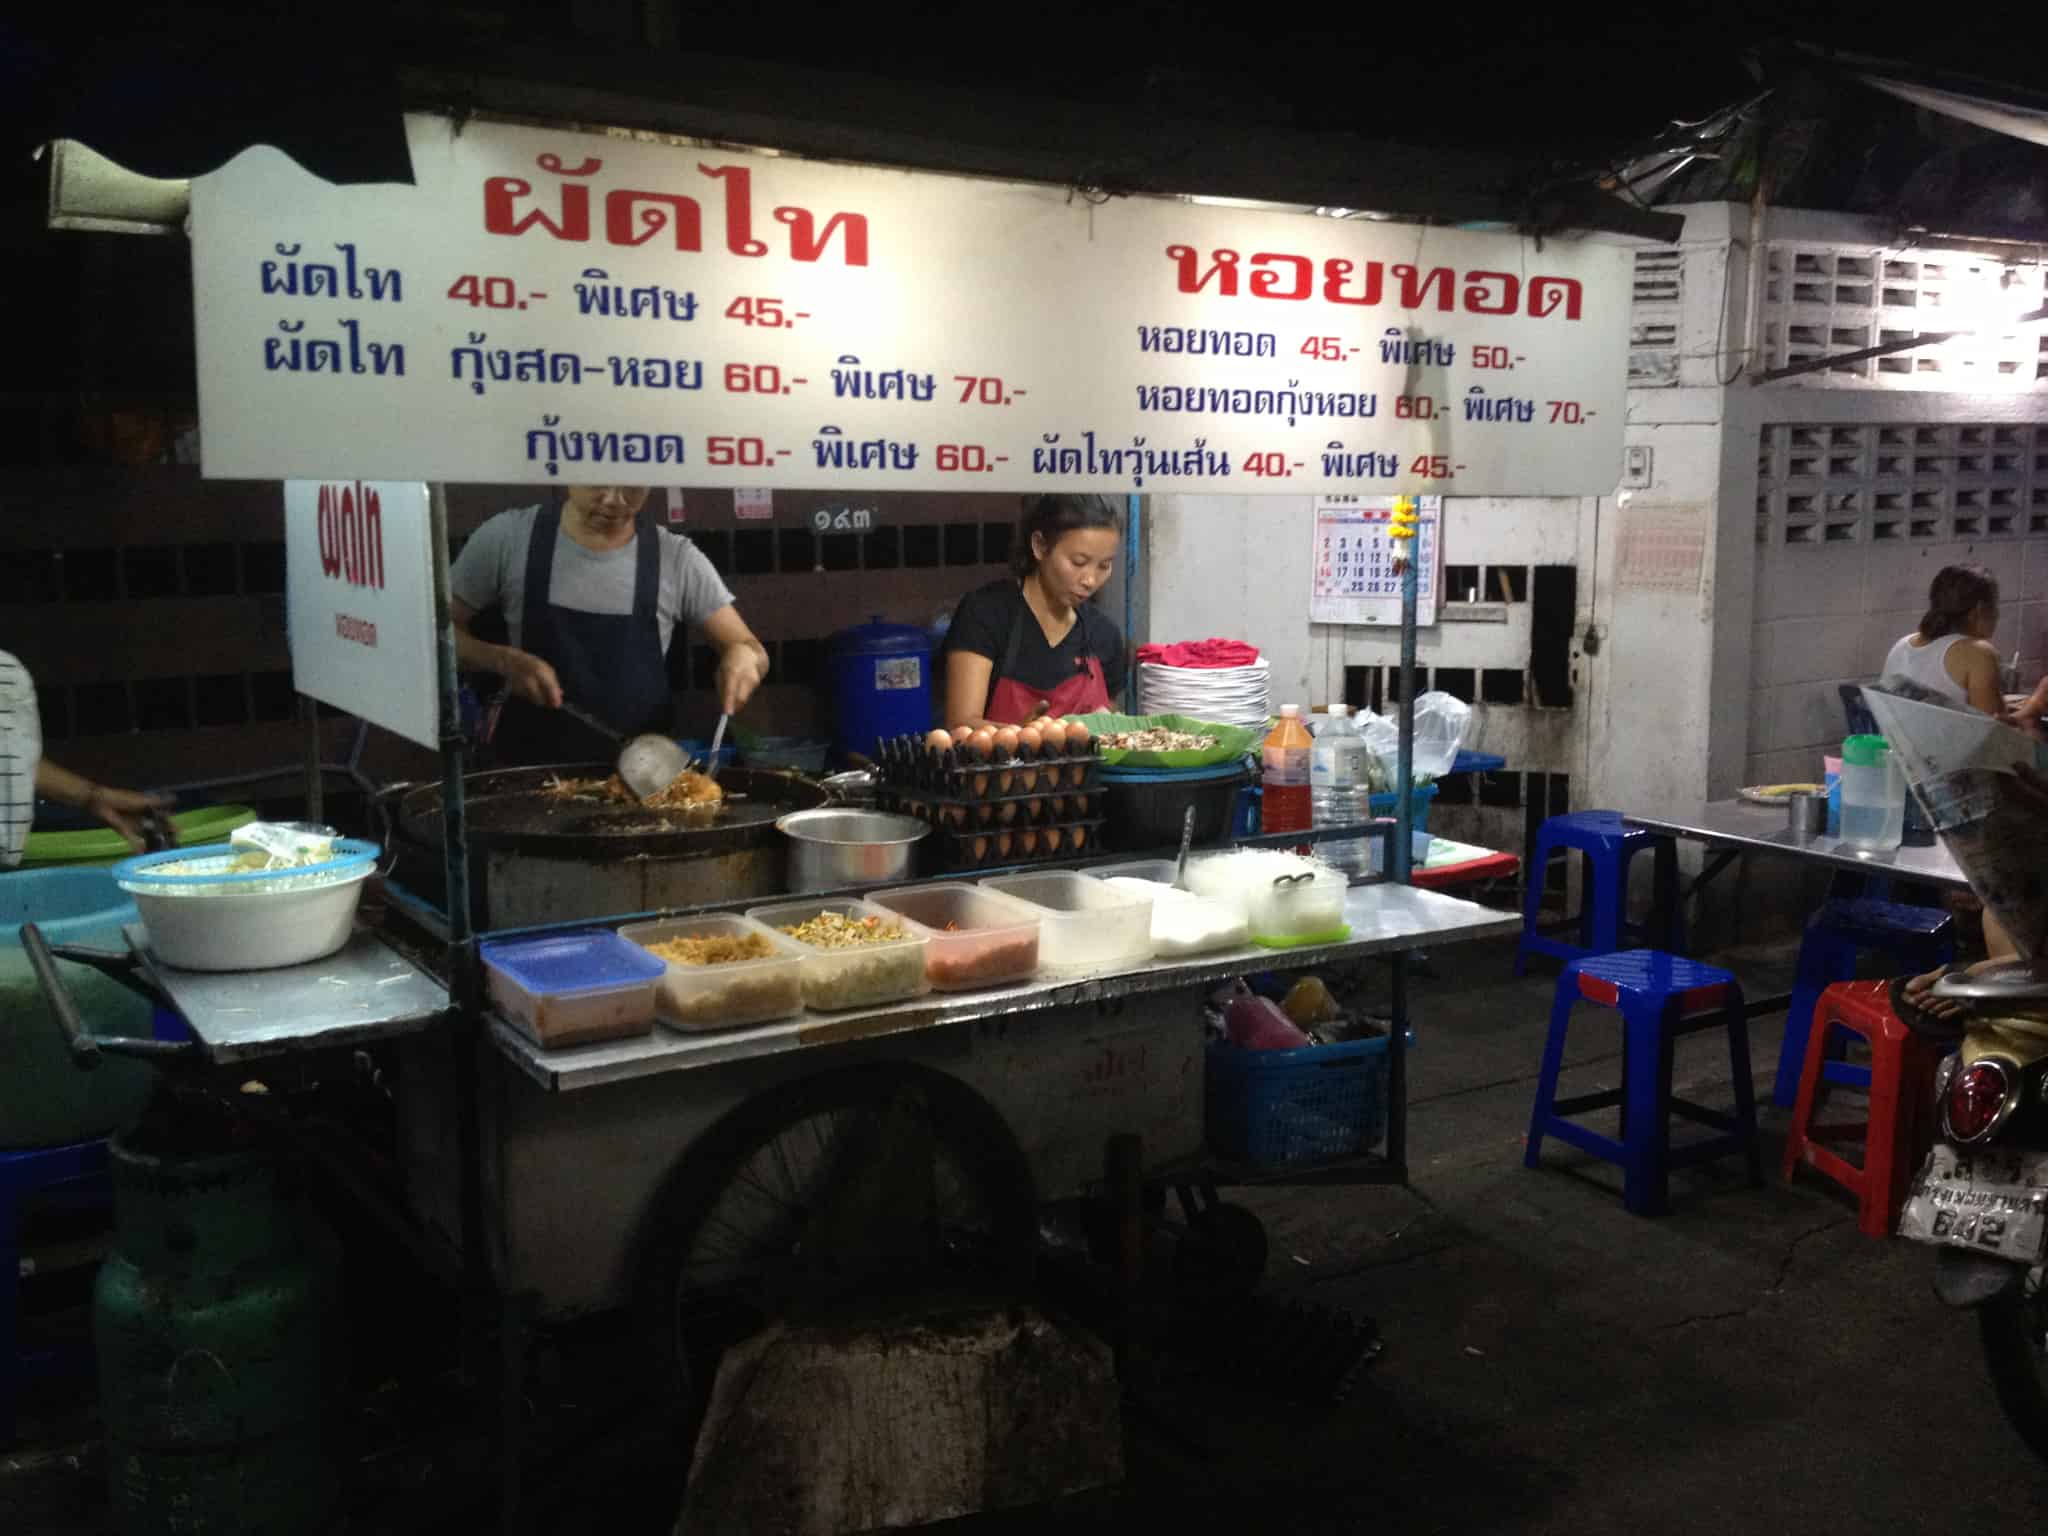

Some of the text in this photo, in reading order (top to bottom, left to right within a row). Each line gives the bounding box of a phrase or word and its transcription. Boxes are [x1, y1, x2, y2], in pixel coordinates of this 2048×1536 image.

[483, 152, 870, 268] ผัดไท
[261, 242, 810, 329] ผัดไท 40.- พิเศษ 45.-
[1165, 243, 1584, 321] หอยทอด
[264, 319, 1027, 406] ผัดไท กุ้งสด-หอย 60.- พิเศษ 70.-
[1136, 325, 1526, 370] หอยทอด 45.- พิเศษ 50.-
[1135, 380, 1596, 427] หอยทอดกุ้งหอย 60.- พิเศษ 70.-
[525, 415, 1009, 477] กุ้งทอด 50.- พิเศษ 60.-
[1033, 431, 1466, 488] ผัดไทวุ้นเส้น 40.- พิเศษ 45.-
